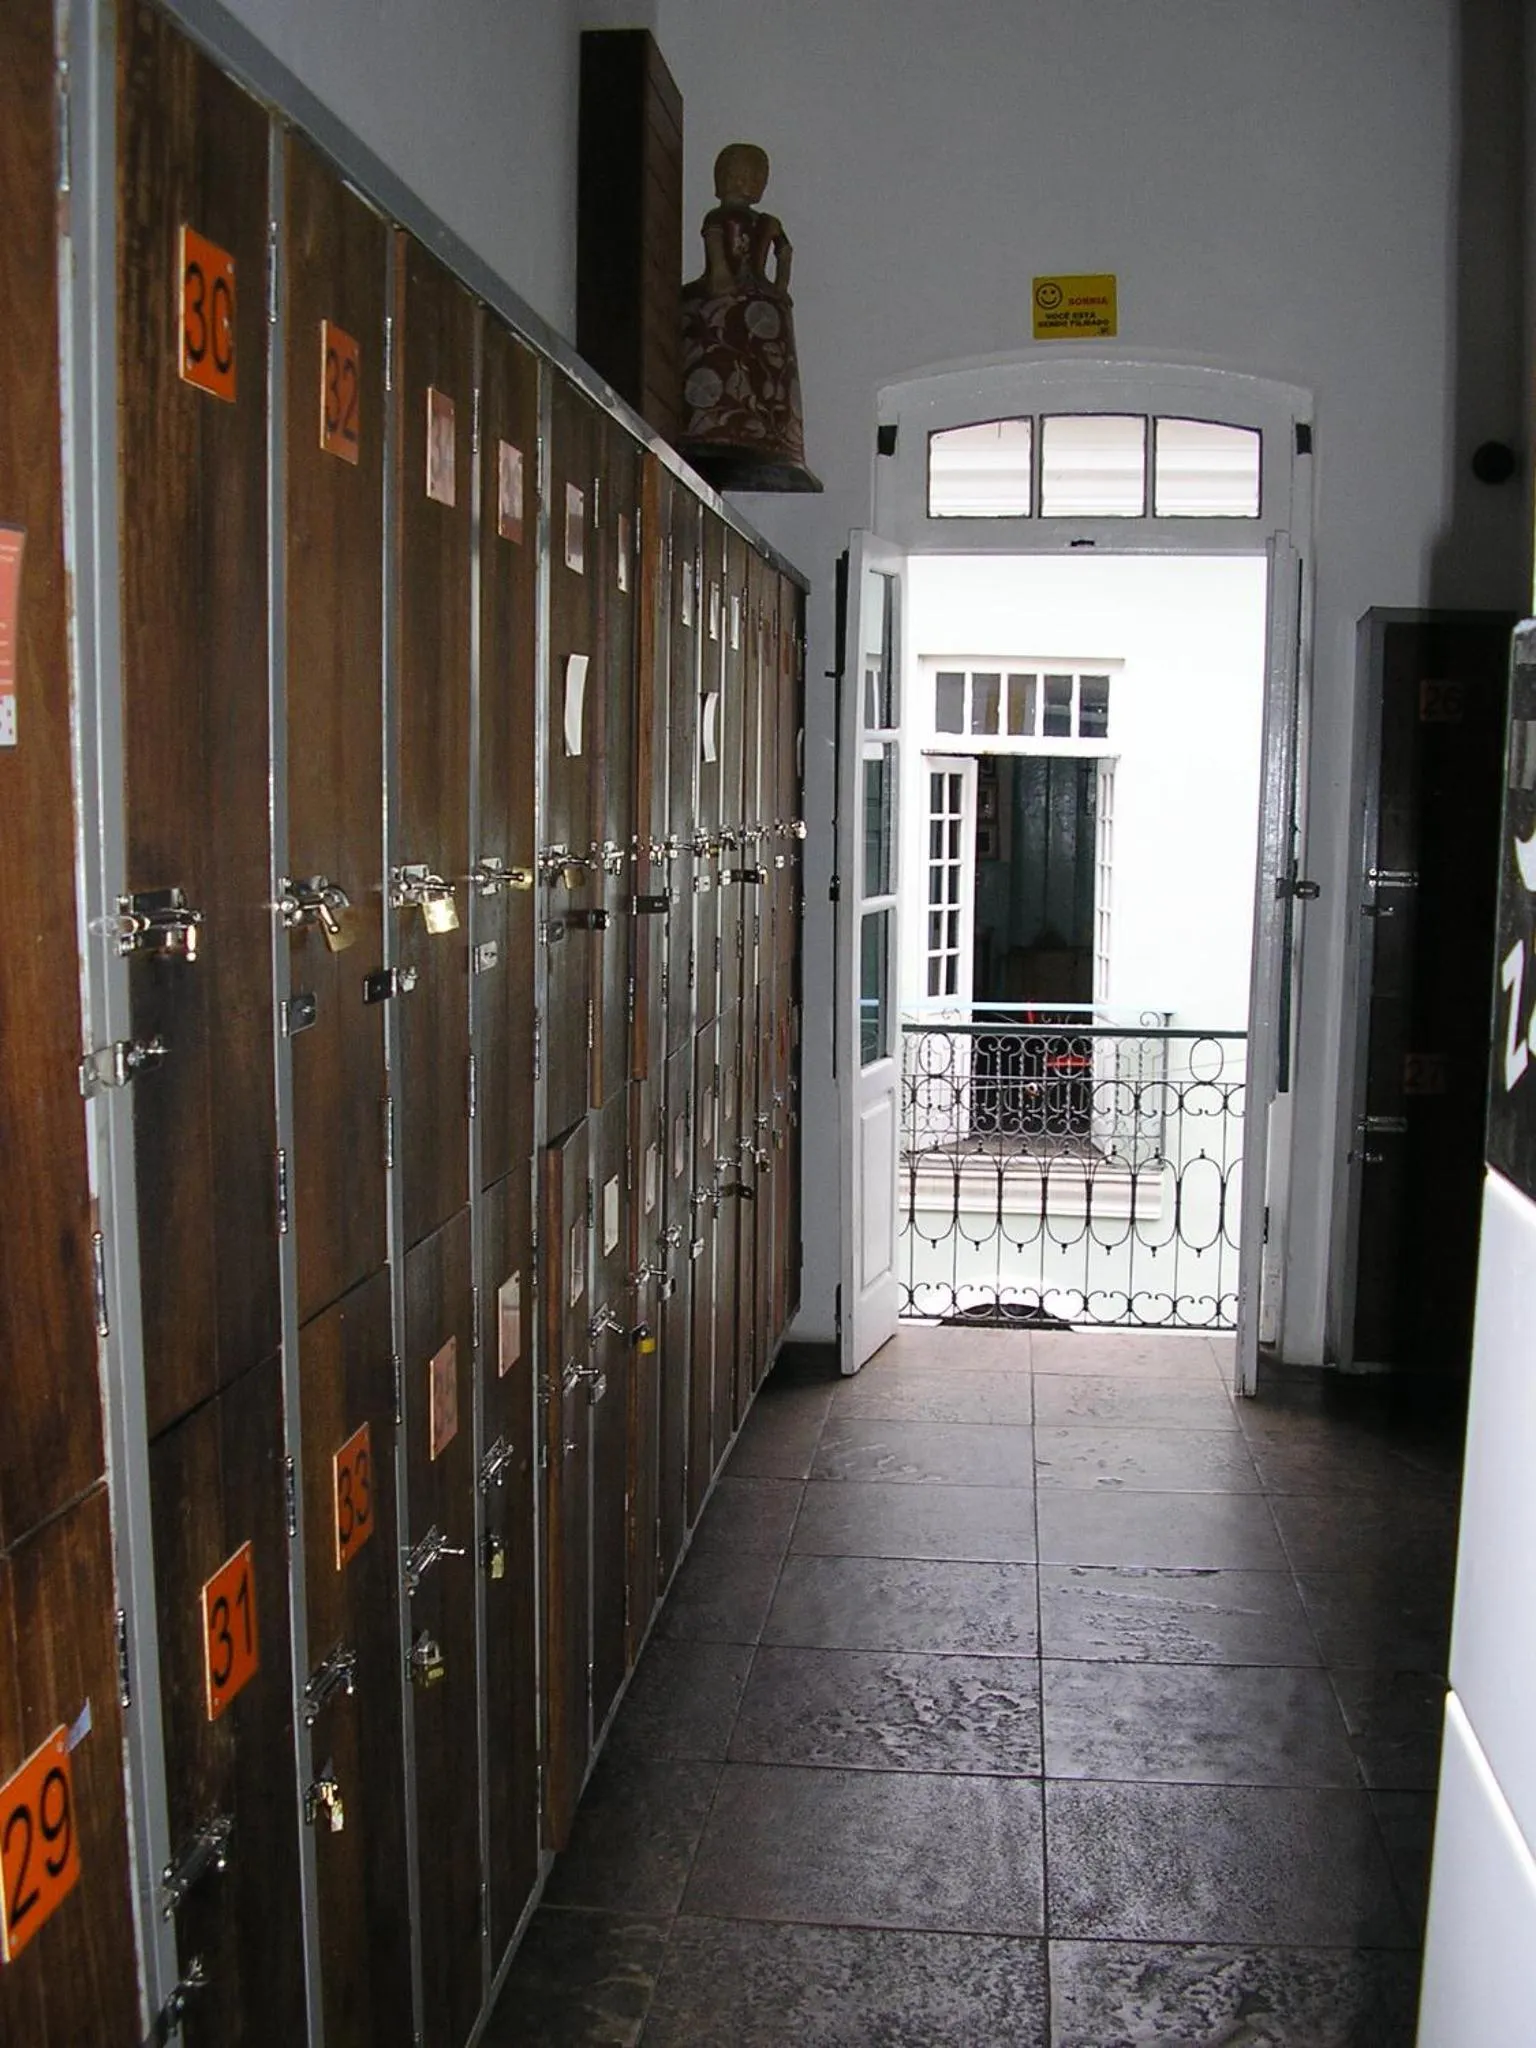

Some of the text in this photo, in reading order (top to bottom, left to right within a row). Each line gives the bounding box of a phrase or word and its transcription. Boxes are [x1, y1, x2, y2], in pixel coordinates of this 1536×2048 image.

[185, 261, 232, 374] 30
[325, 348, 357, 441] 32
[338, 1450, 370, 1544] 33
[212, 1574, 252, 1688] 31
[5, 1767, 70, 1928] 29
